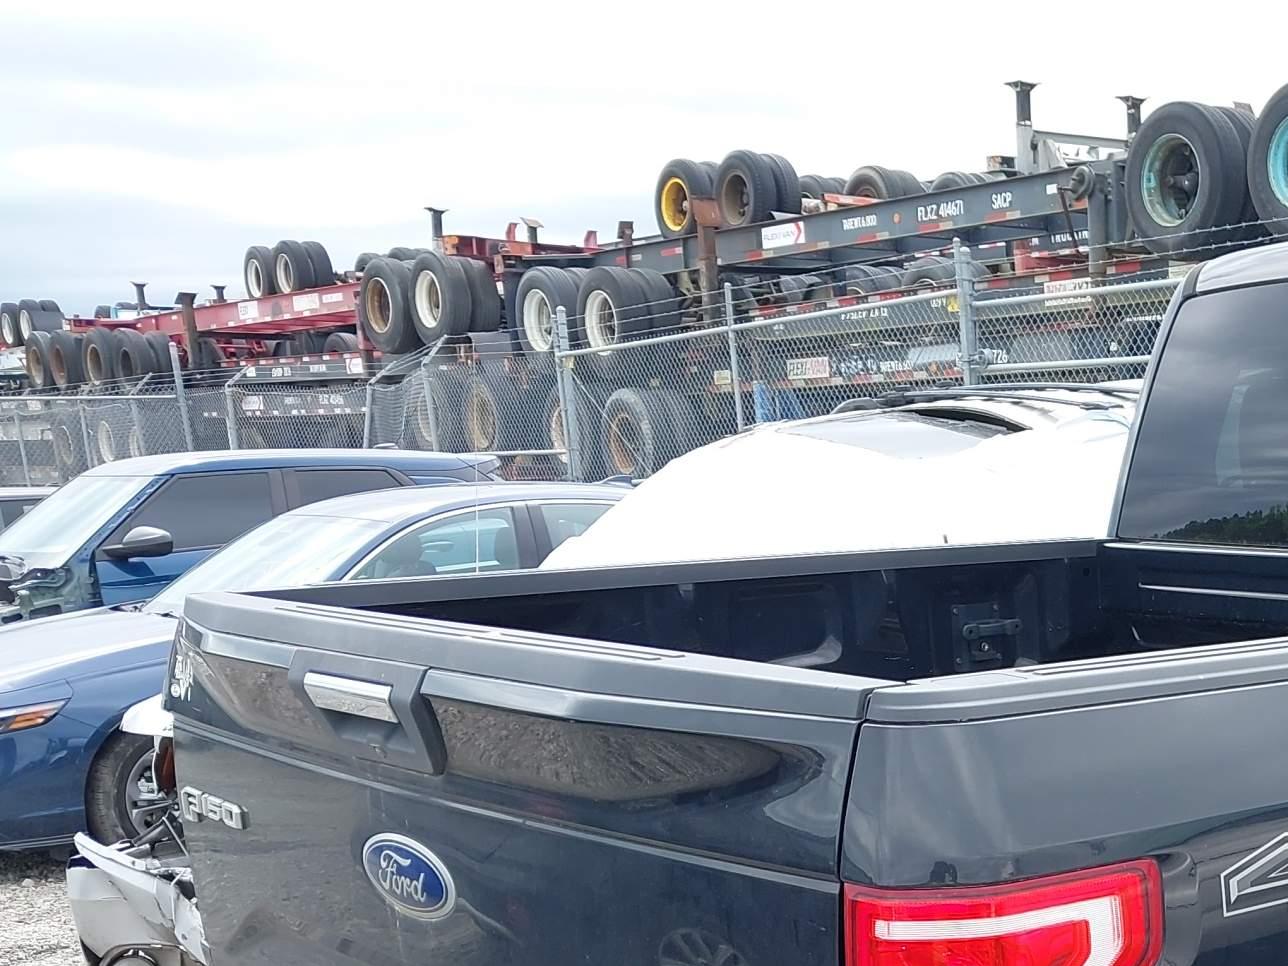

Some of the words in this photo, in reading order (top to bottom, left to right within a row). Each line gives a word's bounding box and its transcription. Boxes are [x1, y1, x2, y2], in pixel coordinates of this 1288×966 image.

[917, 204, 937, 221] FLXZ
[991, 191, 1012, 209] SACP
[379, 848, 428, 903] Ford
